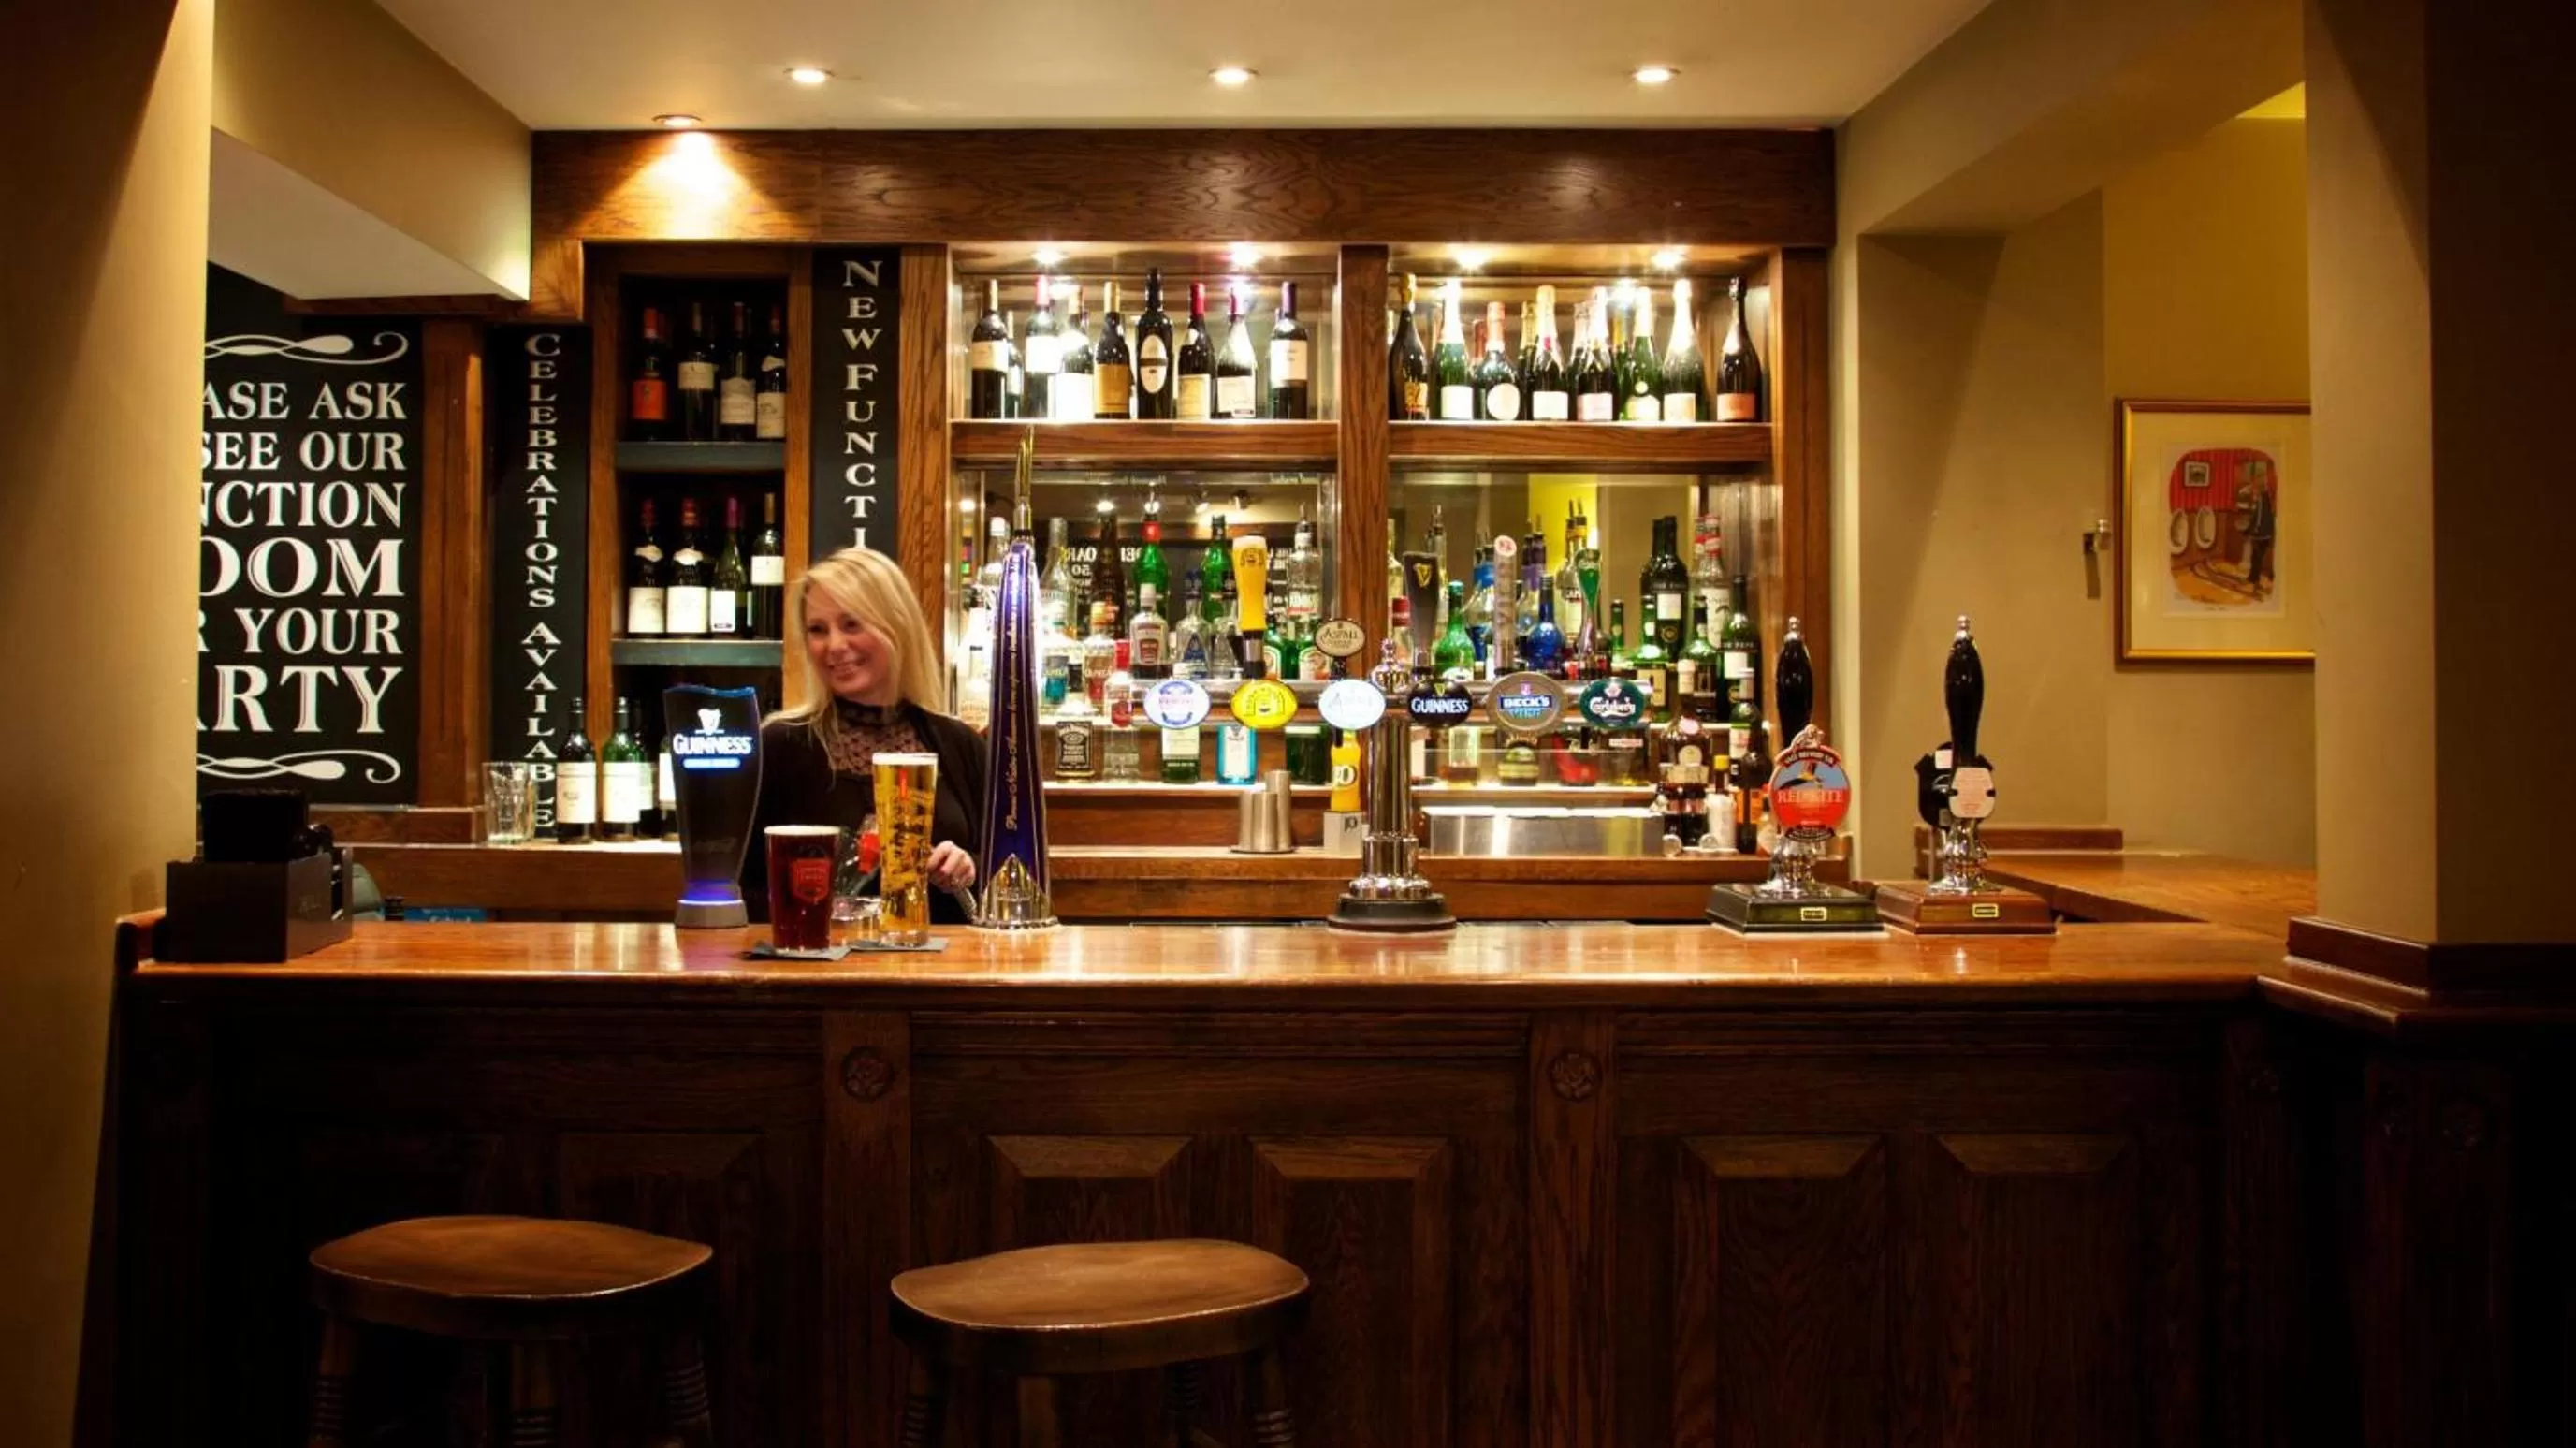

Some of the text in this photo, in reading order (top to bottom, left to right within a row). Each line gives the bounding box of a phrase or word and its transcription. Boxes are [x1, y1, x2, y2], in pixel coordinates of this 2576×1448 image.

[842, 260, 883, 350] NEW
[309, 382, 407, 420] ASK
[299, 431, 406, 471] OUR
[524, 333, 560, 608] CELEBRATIONS
[234, 607, 402, 655] YOUR
[196, 665, 403, 733] RTY
[1411, 696, 1470, 714] GUINNESS
[673, 733, 753, 755] GUINNESS
